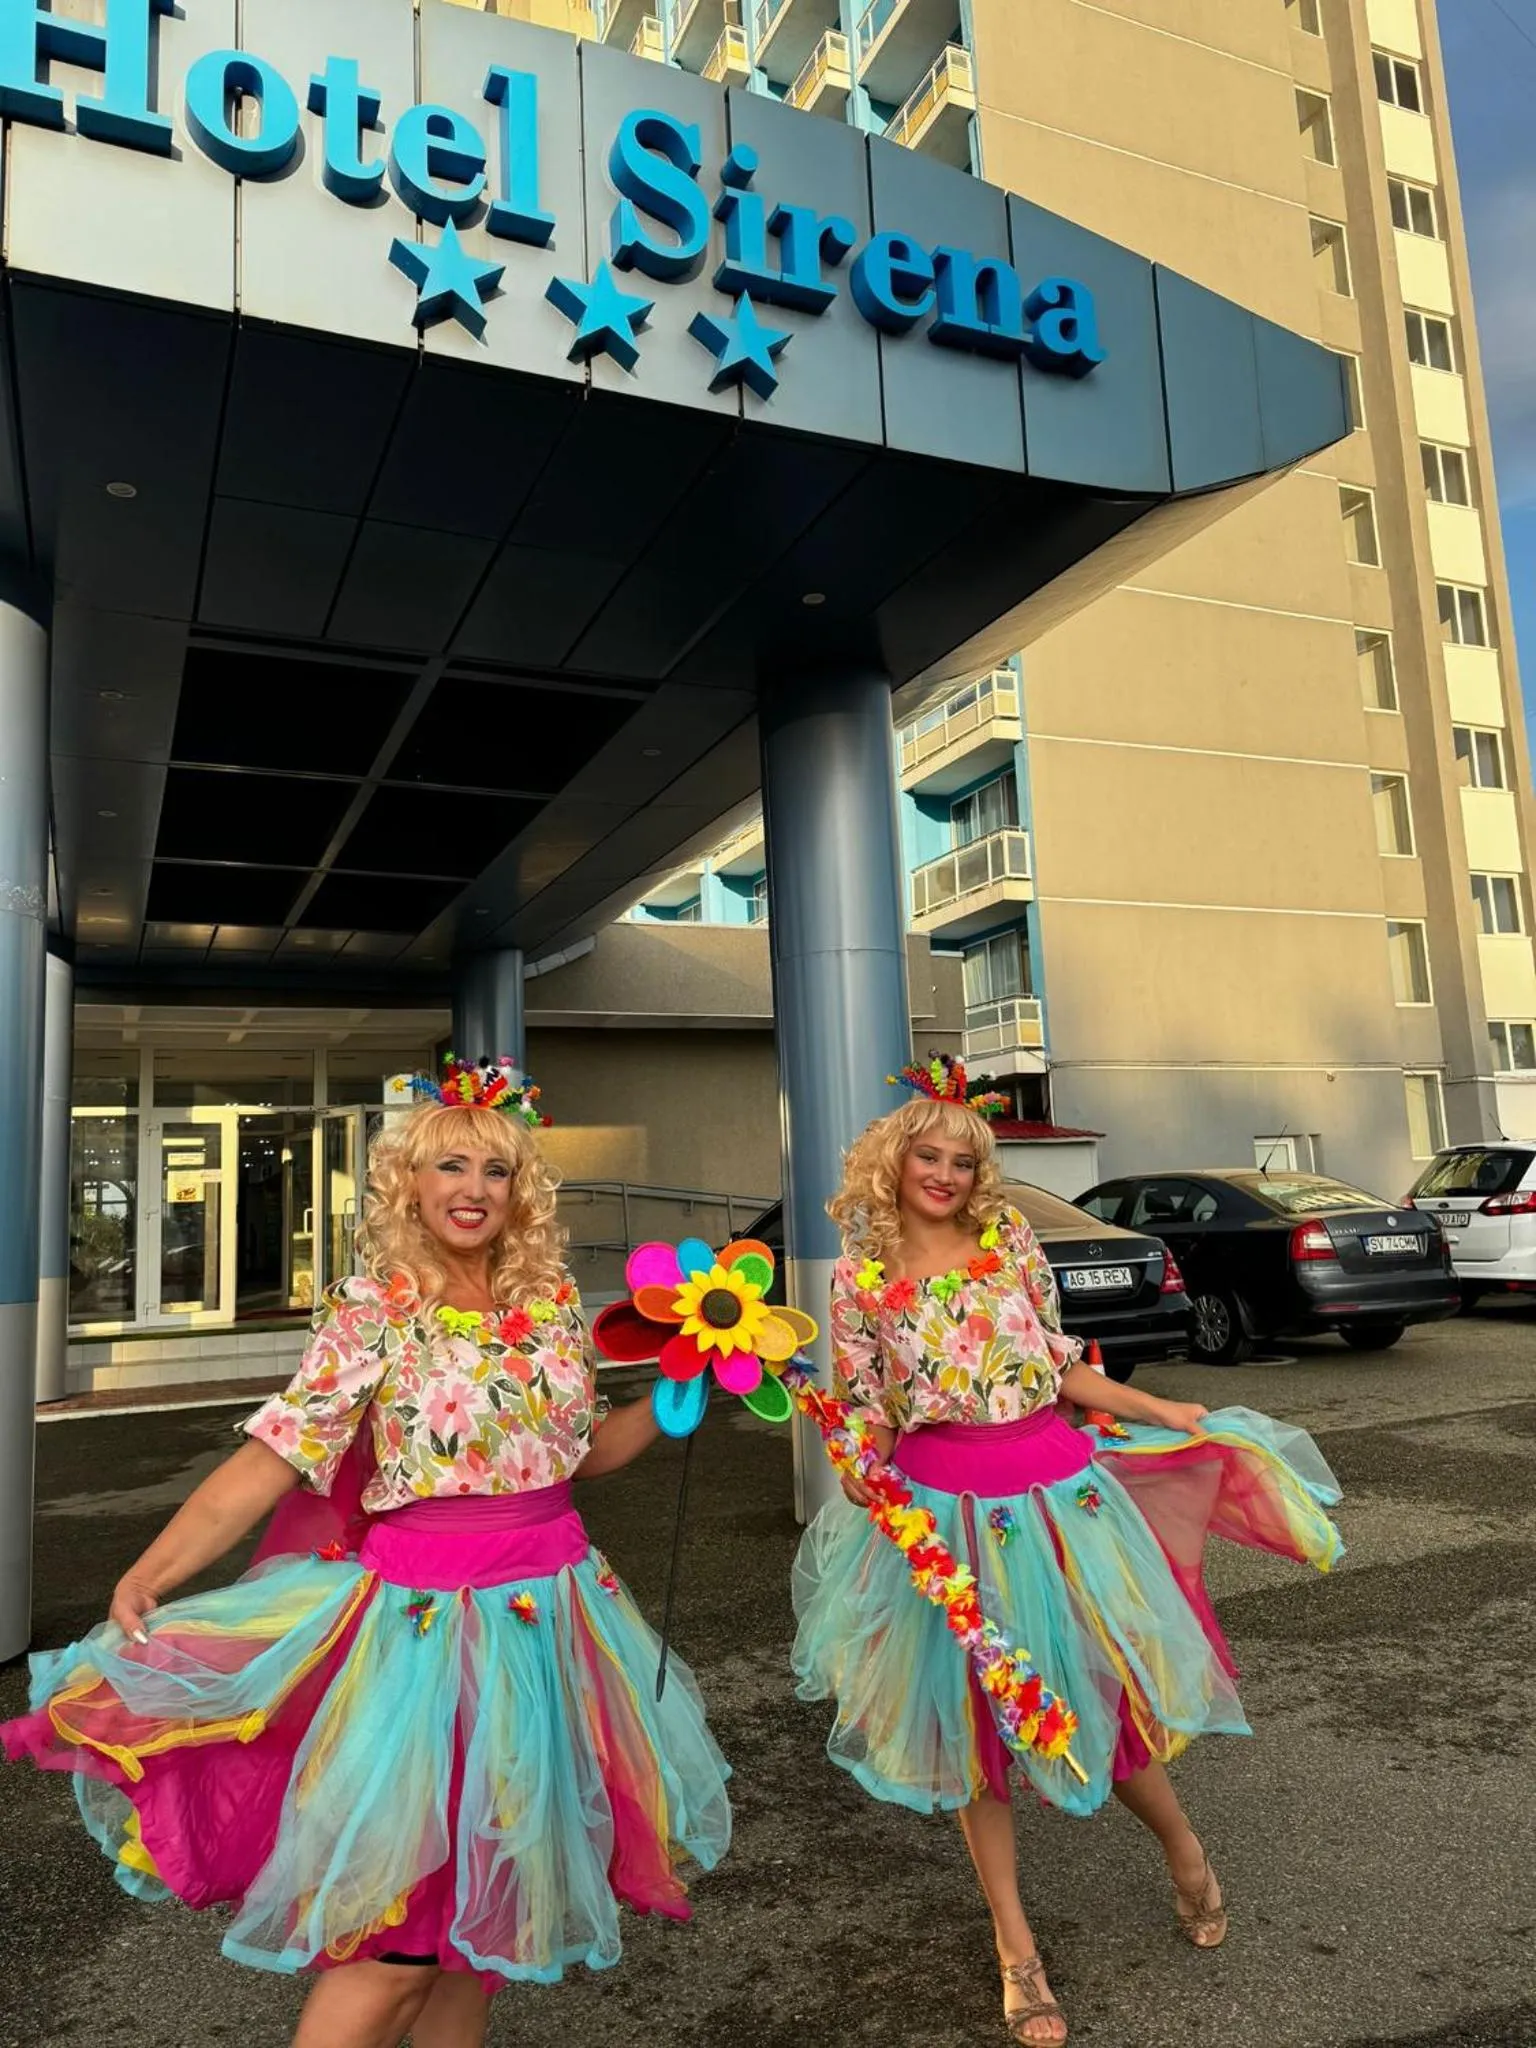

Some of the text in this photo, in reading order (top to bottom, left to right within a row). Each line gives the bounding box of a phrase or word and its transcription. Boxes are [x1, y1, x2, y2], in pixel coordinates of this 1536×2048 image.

[0, 0, 1107, 378] Hotel Sirena
[1070, 1272, 1086, 1287] AG
[1103, 1269, 1130, 1284] REX
